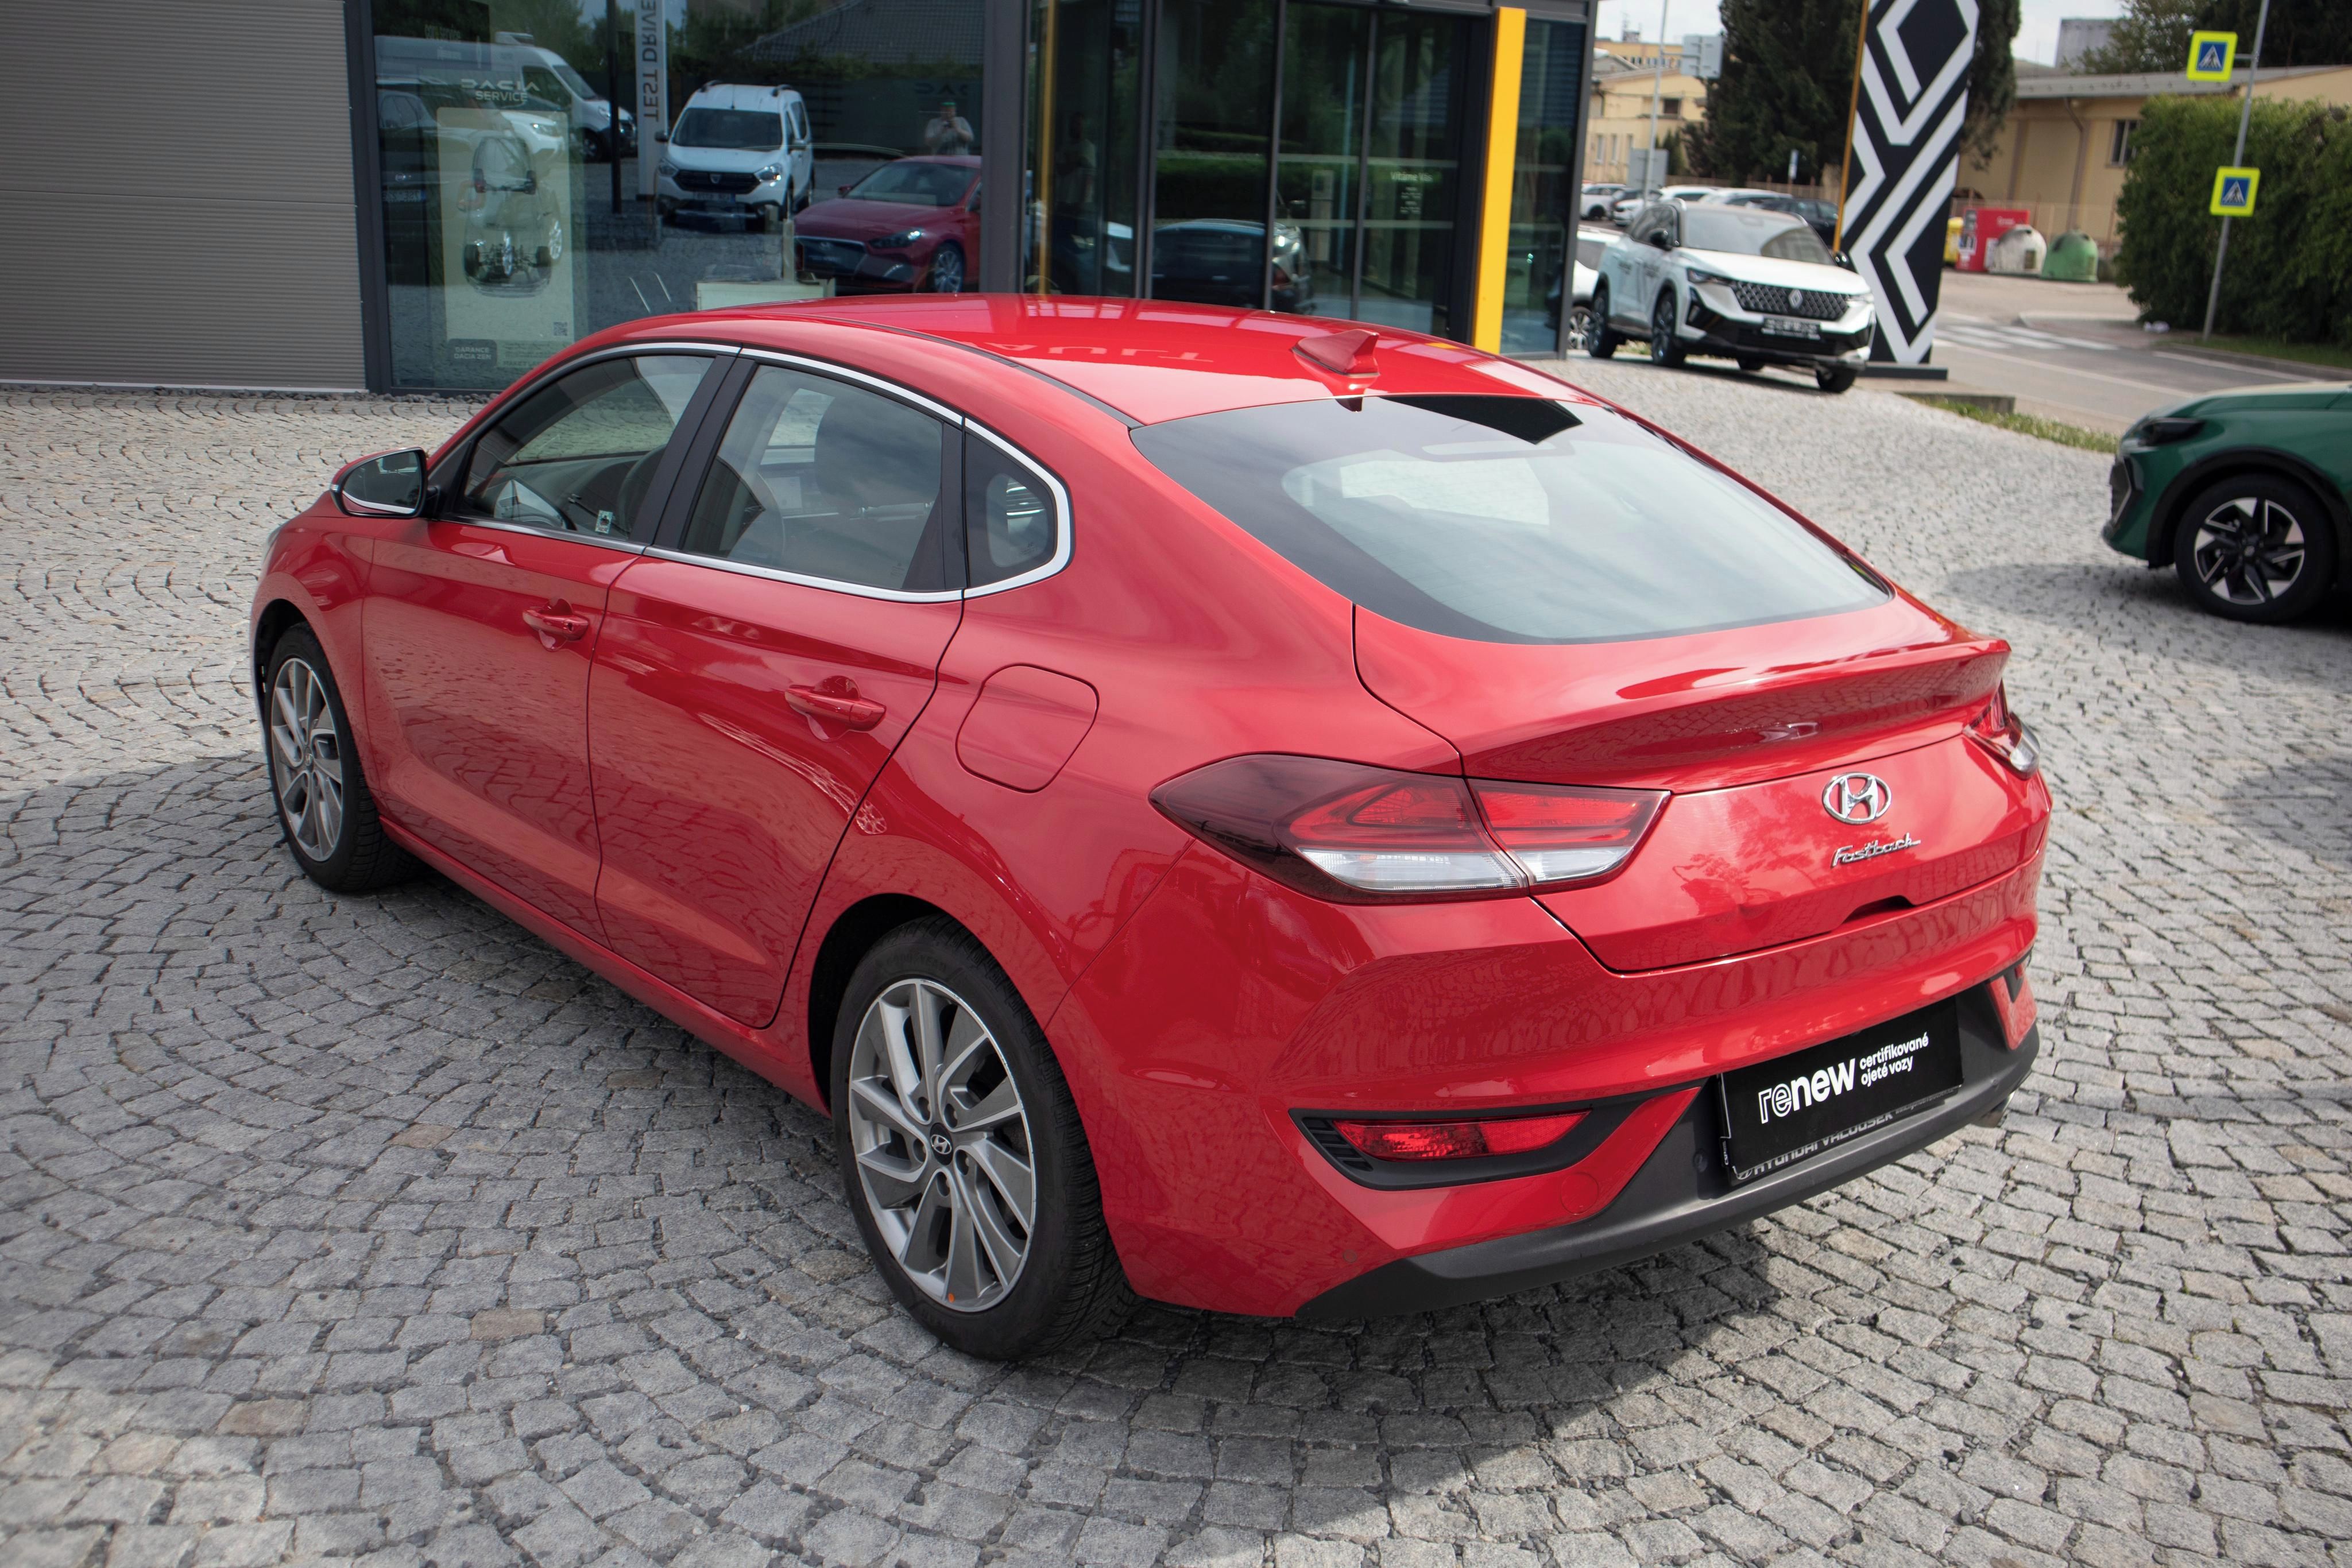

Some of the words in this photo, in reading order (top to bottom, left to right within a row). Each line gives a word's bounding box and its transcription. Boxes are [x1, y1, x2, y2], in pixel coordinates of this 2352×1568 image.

[461, 79, 540, 91] DACIA
[475, 90, 528, 102] SERVICE
[1831, 833, 1921, 869] Fastback
[1758, 1058, 1856, 1124] renew
[1859, 1032, 1929, 1070] certifikované
[1860, 1064, 1889, 1087] ojeté
[1889, 1056, 1914, 1075] vozy
